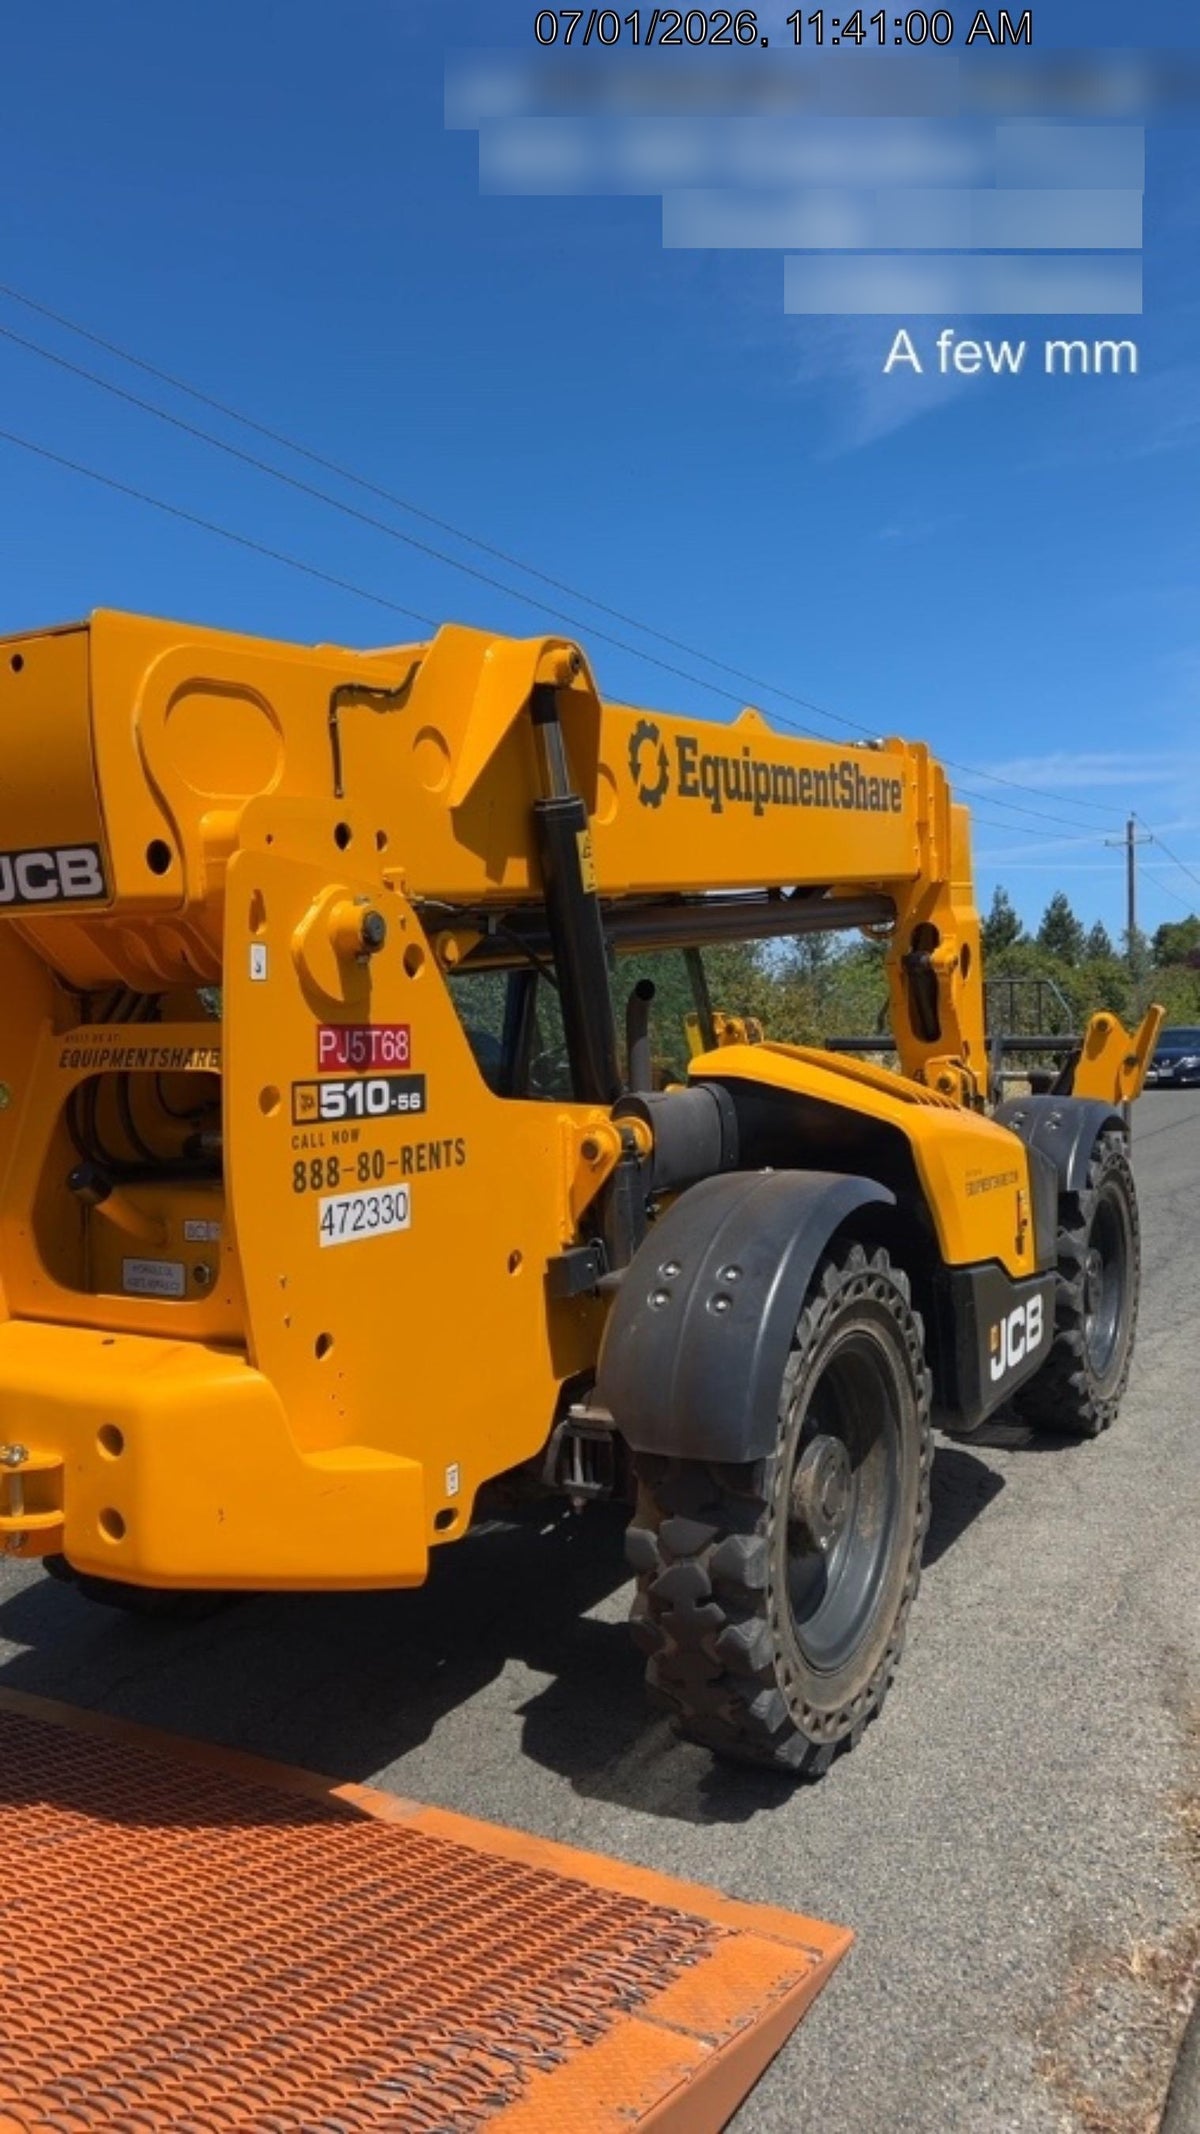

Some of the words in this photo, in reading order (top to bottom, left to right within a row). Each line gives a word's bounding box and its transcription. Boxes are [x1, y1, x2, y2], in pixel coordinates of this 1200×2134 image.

[675, 735, 903, 816] EquipmentShare
[319, 1030, 409, 1063] PJ5T68
[292, 1132, 325, 1150] CALL
[332, 1128, 361, 1144] NOW
[293, 1138, 466, 1193] 888-80-RENTS
[320, 1192, 408, 1236] 472330
[990, 1294, 1043, 1381] JCB
